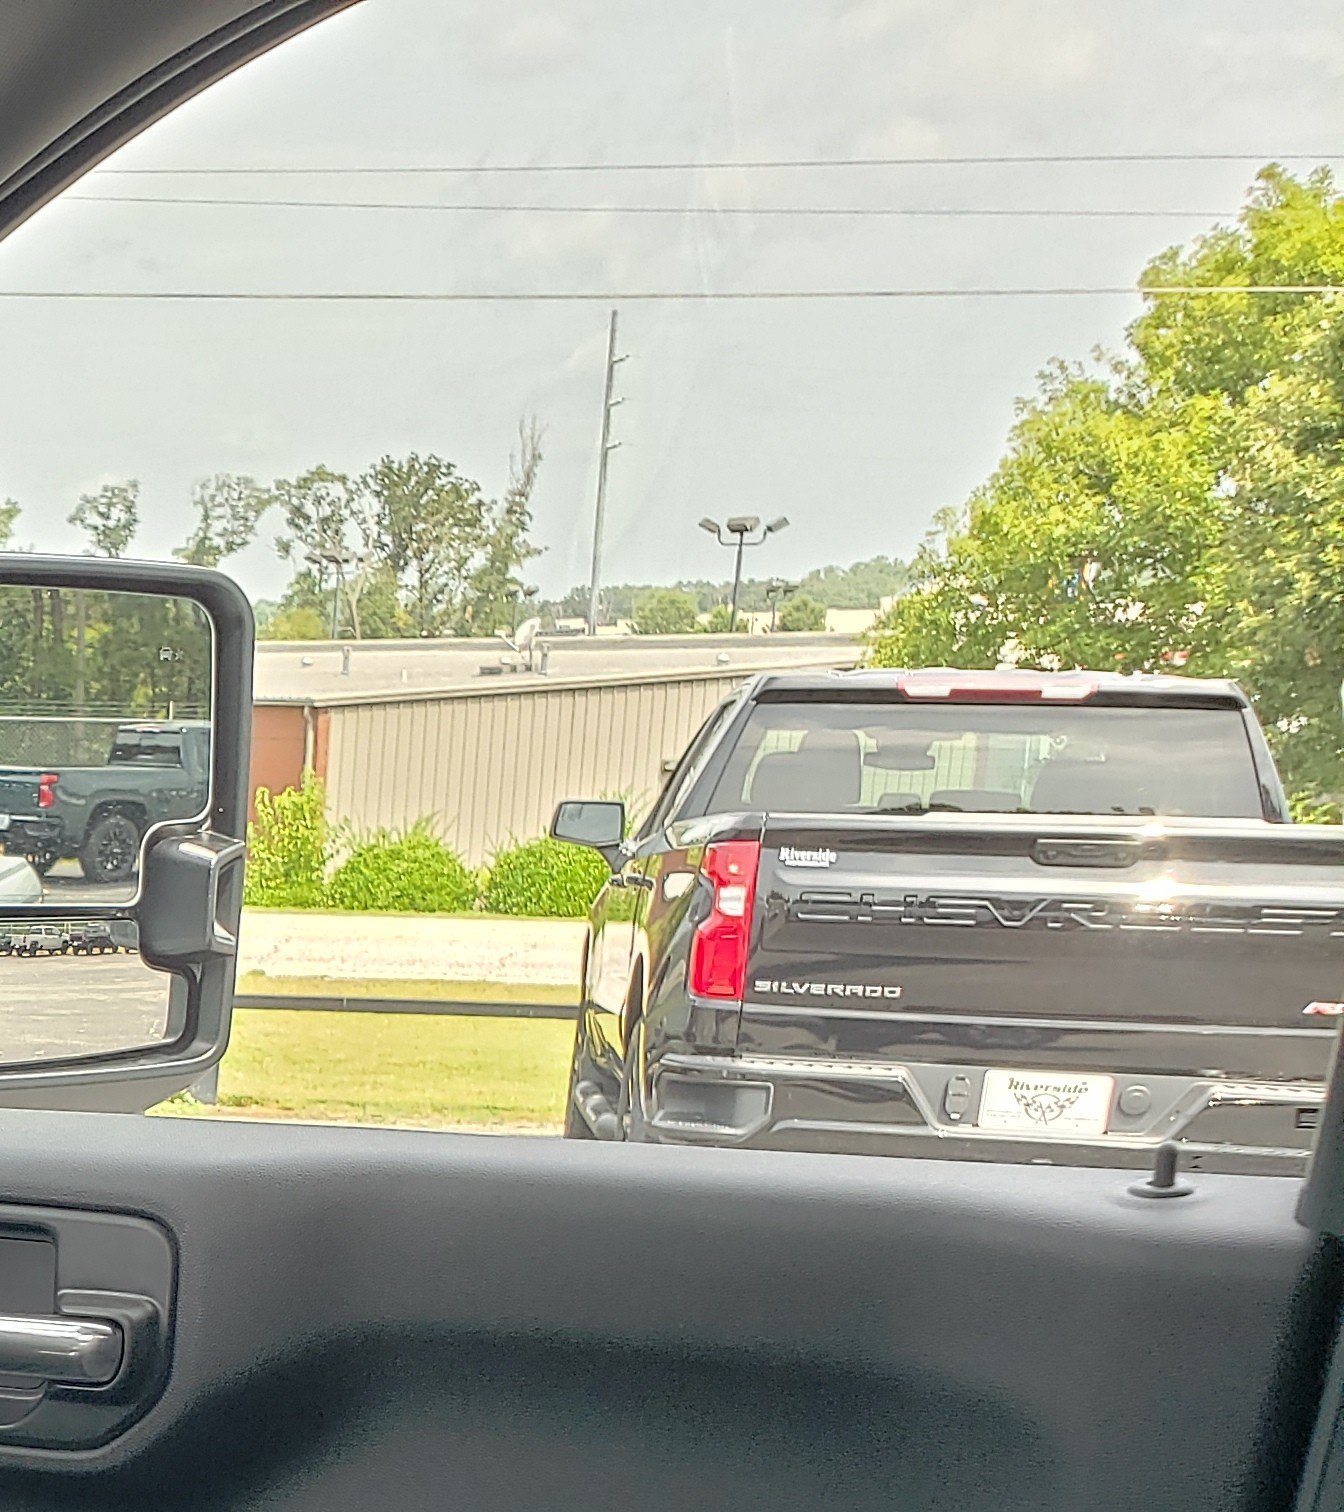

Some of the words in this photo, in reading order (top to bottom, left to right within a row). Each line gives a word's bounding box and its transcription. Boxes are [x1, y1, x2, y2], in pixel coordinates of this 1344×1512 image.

[778, 846, 838, 863] Riverside
[753, 980, 903, 999] SILVERADO
[1007, 1077, 1089, 1094] Riverside
